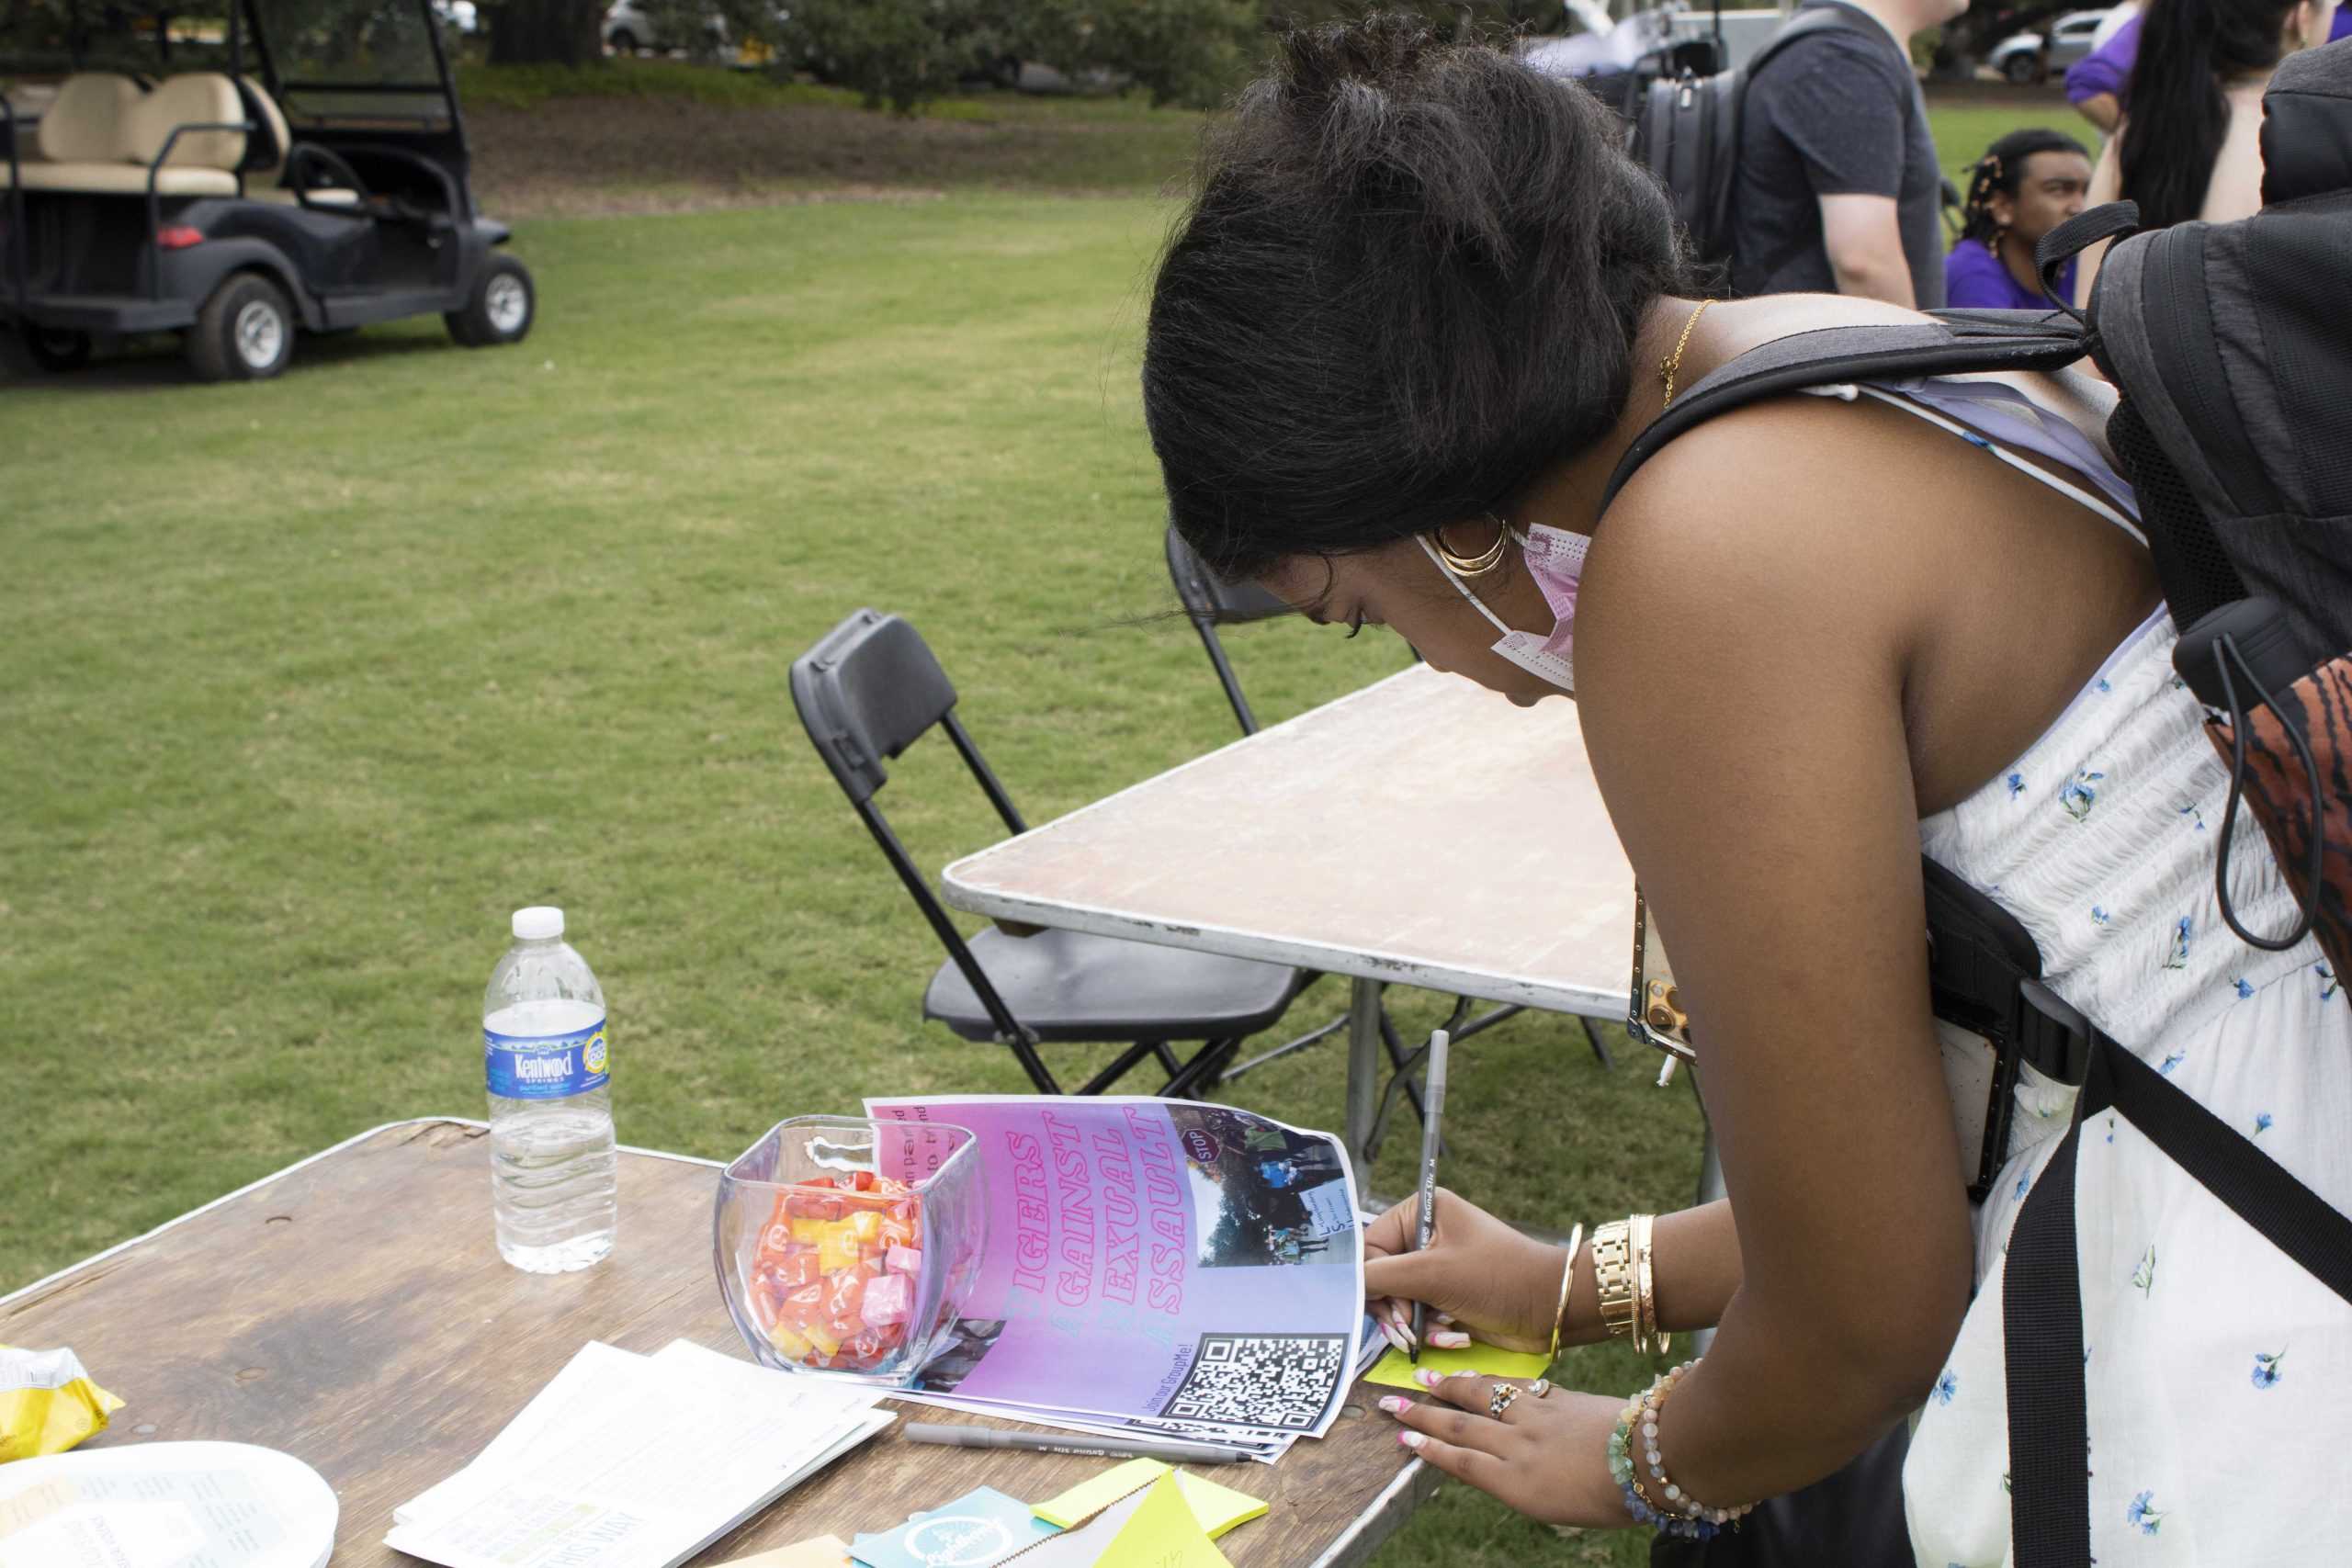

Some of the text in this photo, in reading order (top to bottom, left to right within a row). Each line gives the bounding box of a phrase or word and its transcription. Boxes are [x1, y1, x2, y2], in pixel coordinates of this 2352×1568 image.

[514, 1051, 573, 1078] Kentwood
[1190, 1132, 1213, 1160] STOP
[1161, 1344, 1193, 1384] GroupMe!
